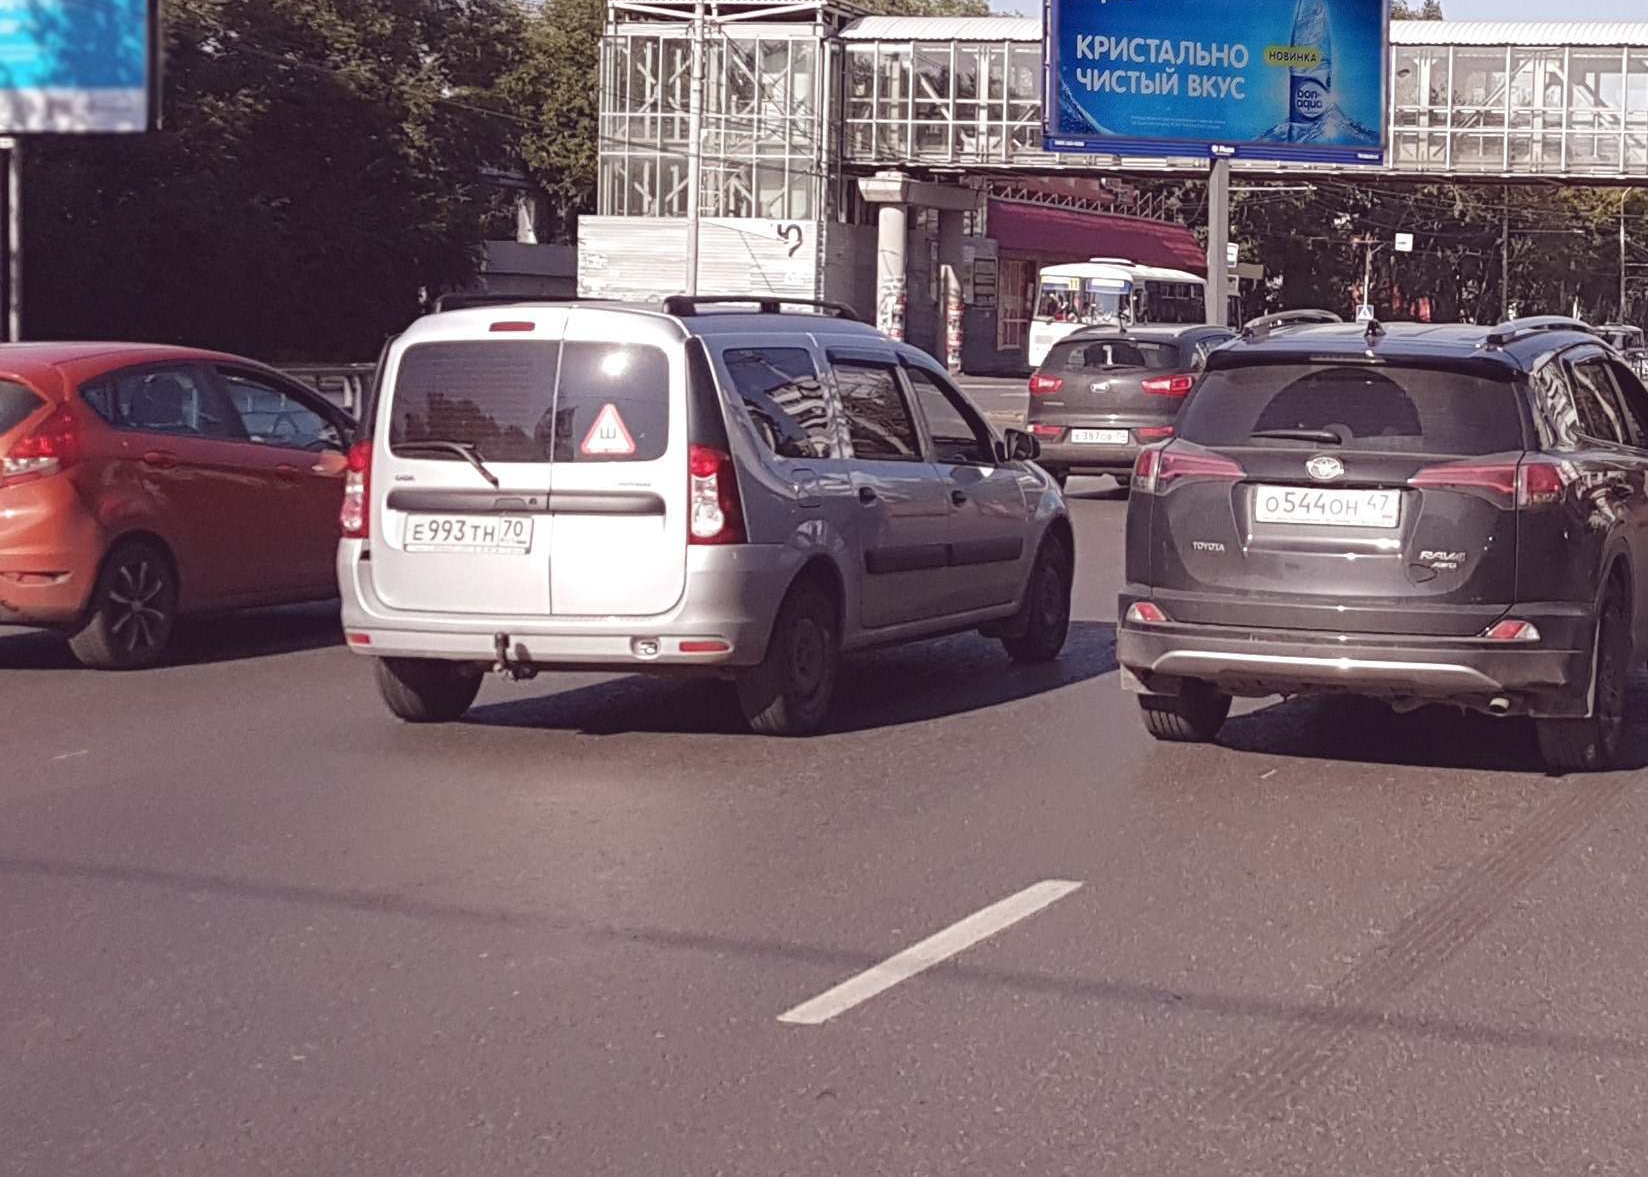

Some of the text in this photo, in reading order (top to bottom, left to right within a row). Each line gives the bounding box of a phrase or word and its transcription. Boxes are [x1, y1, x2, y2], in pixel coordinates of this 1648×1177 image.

[1076, 34, 1249, 69] КРИСТАЛЬНО
[1268, 51, 1317, 62] НОВИНКА
[1076, 66, 1246, 100] ЧИСТЫЙ ВКУС
[1367, 494, 1389, 511] 47
[504, 520, 524, 537] 70
[1192, 541, 1225, 552] TOYOTA
